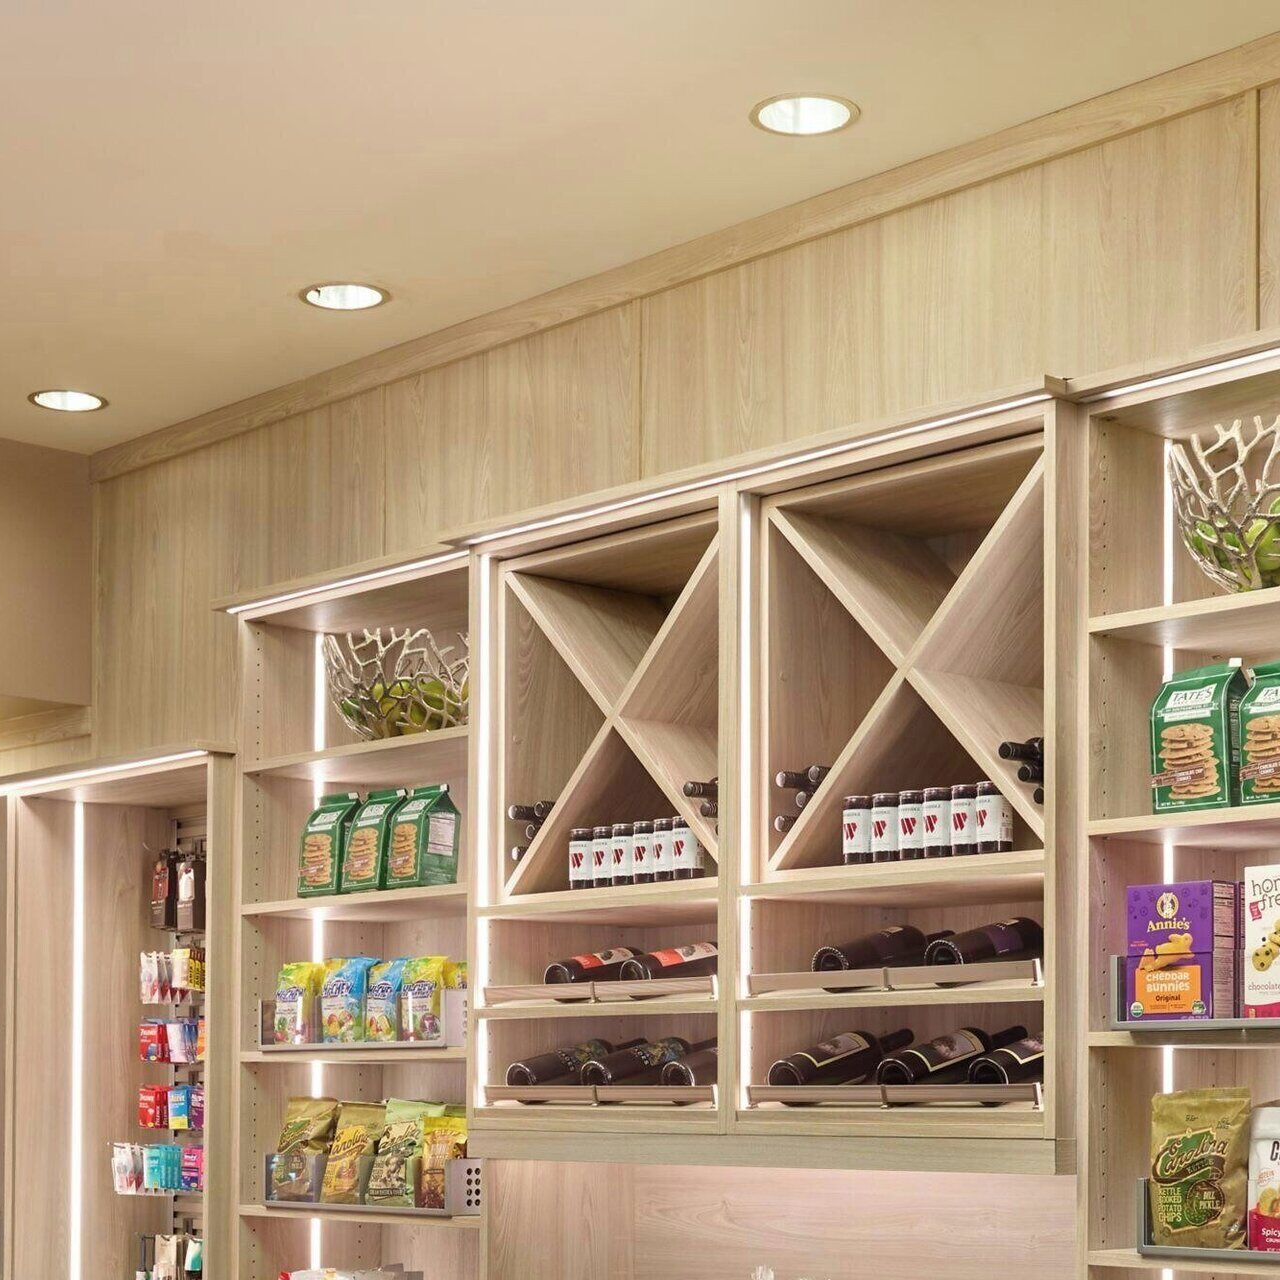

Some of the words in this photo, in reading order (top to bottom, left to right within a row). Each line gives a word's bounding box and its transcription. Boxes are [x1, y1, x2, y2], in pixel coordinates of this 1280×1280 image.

[1174, 688, 1212, 701] TATE'S
[1147, 917, 1190, 933] Annie's
[1155, 994, 1181, 1002] Original
[1158, 1213, 1181, 1222] CHIPS
